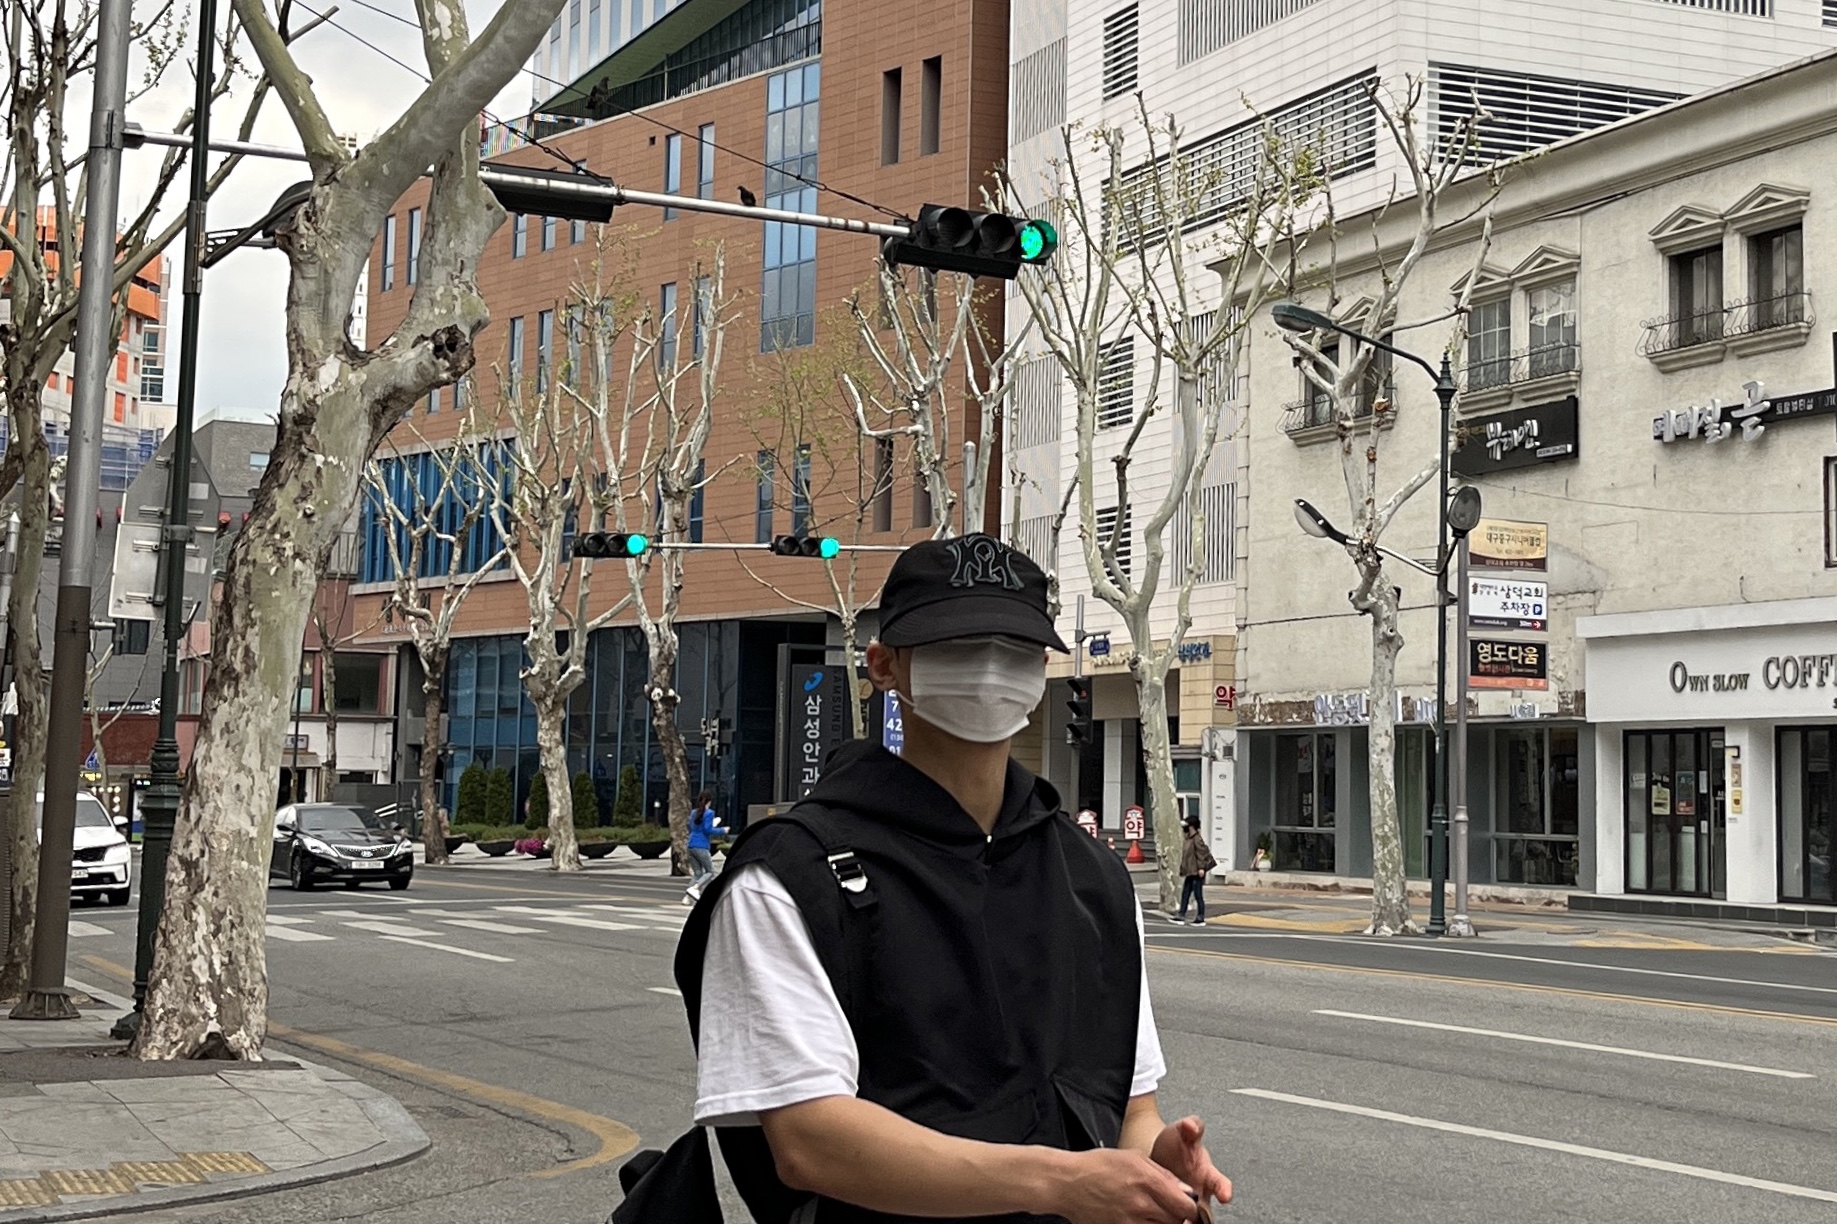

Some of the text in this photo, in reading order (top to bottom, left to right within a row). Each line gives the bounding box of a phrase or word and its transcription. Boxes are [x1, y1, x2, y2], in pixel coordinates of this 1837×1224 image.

[1500, 585, 1544, 600] 삼덕교회
[1500, 601, 1530, 616] 주차장
[1477, 642, 1539, 666] 영도다움
[1713, 673, 1751, 692] SLOW
[1762, 655, 1837, 690] COFF
[1215, 685, 1236, 712] 약
[801, 694, 822, 785] 삼성안과
[1126, 820, 1144, 838] 약
